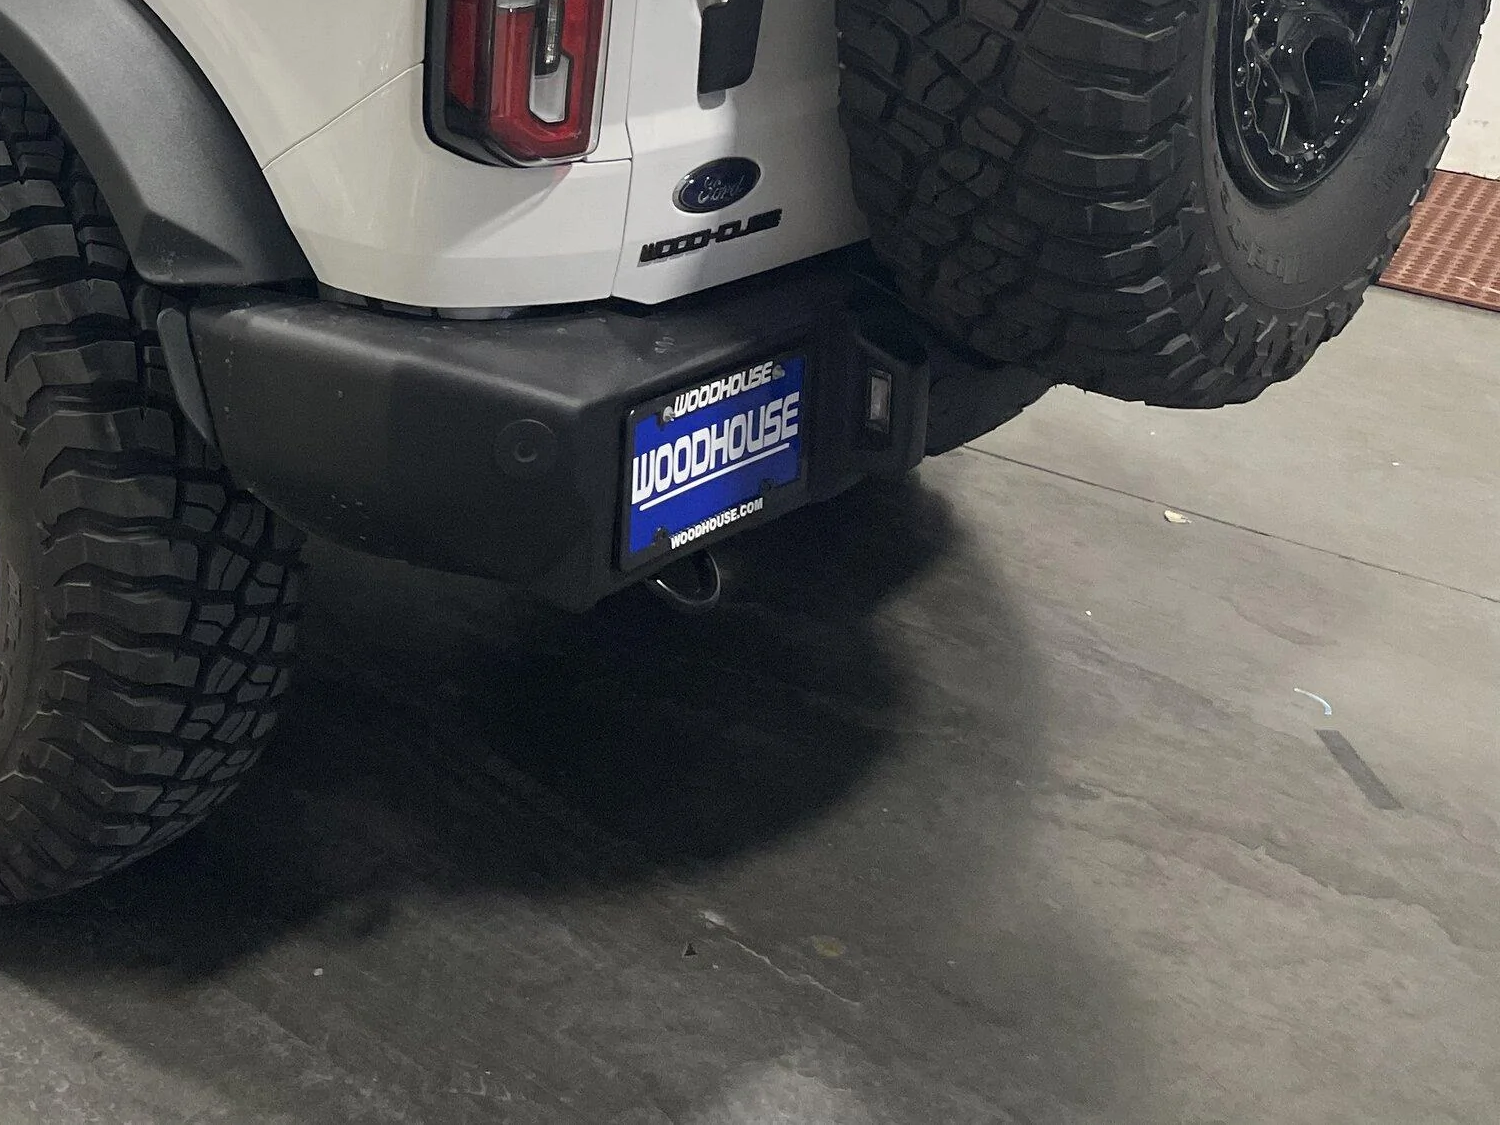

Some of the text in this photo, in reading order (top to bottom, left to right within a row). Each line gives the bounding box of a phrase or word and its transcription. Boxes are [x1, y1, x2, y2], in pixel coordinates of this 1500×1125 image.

[674, 361, 773, 417] WOODHOUSE
[631, 391, 800, 505] WOODHOUSE
[670, 498, 763, 549] WOODHOUSE.COM
